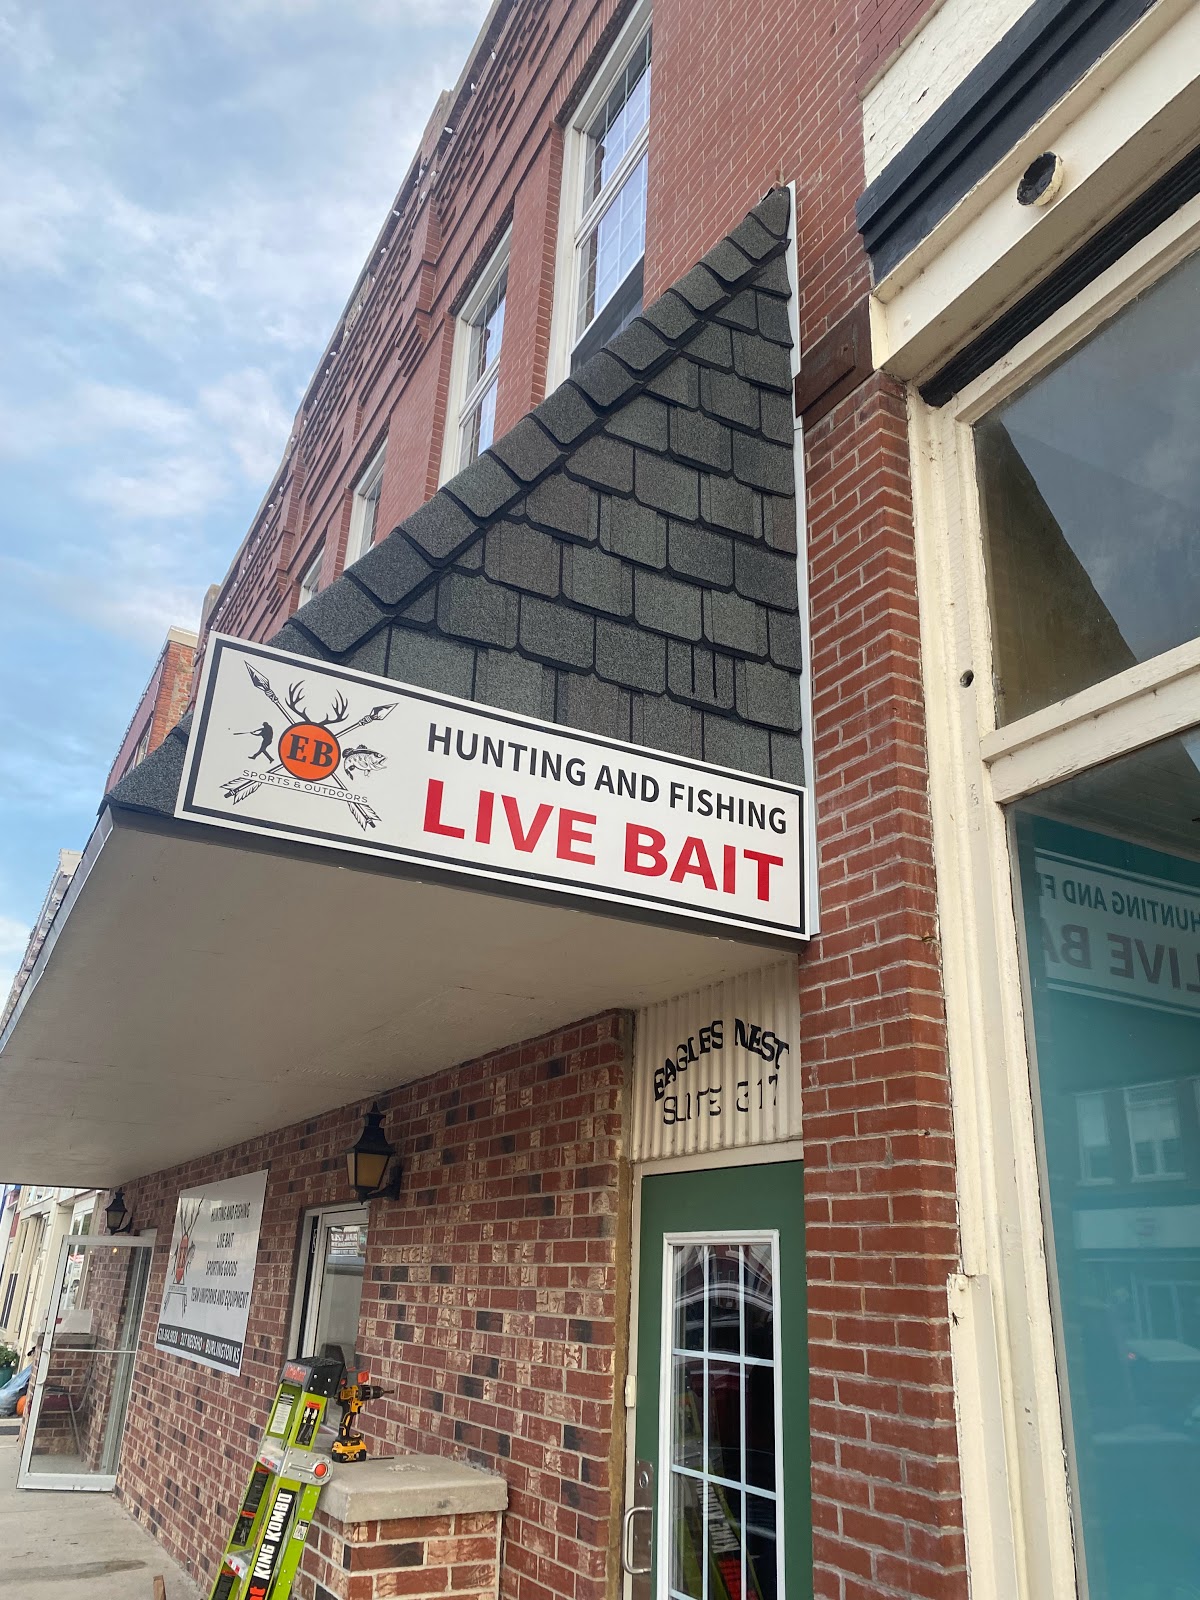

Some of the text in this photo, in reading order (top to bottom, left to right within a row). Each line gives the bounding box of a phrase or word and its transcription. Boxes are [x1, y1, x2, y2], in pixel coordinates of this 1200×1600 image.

[286, 733, 334, 768] EB
[242, 769, 368, 804] SPORTS & OUTDOORS
[427, 722, 787, 835] HUNTING AND FISHING
[423, 778, 784, 902] LIVE BAIT
[653, 1018, 790, 1102] EAGLES NEST
[663, 1073, 779, 1125] SUITE 317
[206, 1261, 238, 1277] SPORTING GOODS
[225, 1290, 249, 1310] EQUIPMENT
[205, 1338, 234, 1362] BURLINGTON
[232, 1346, 240, 1364] KS
[252, 1543, 276, 1581] KING
[264, 1492, 294, 1543] KOMBO
